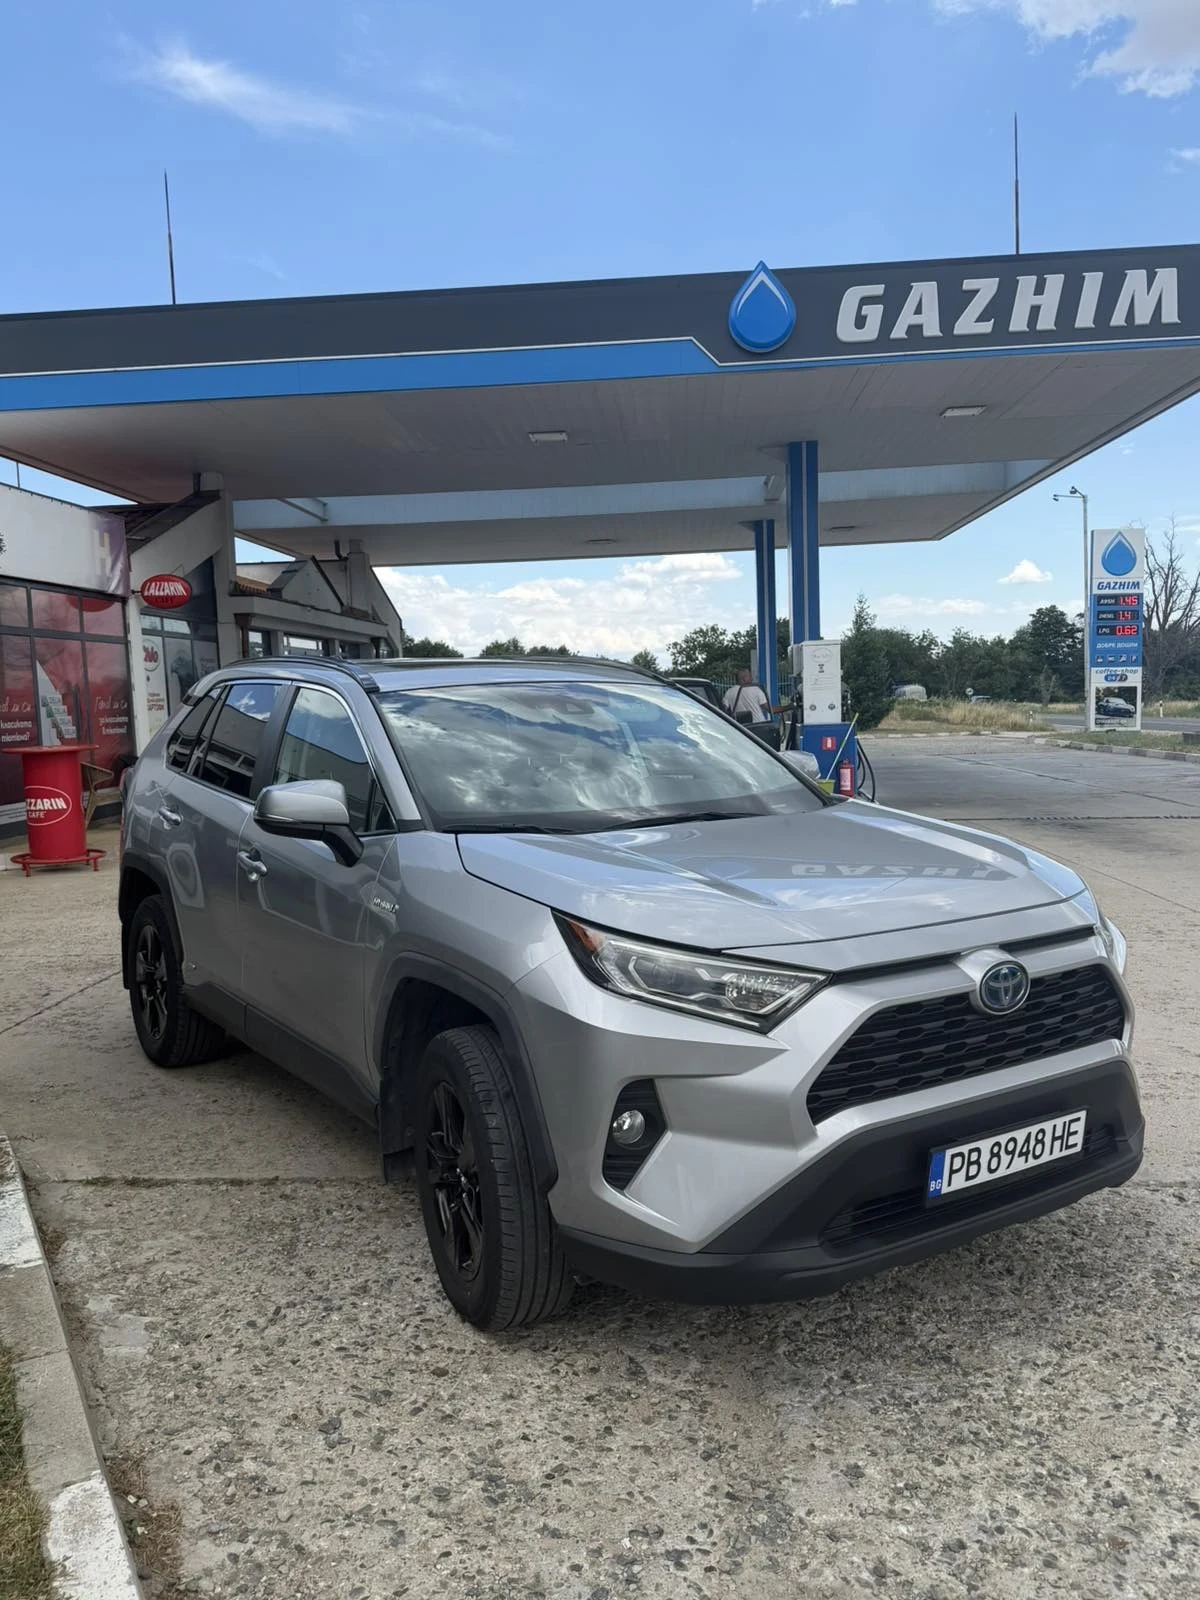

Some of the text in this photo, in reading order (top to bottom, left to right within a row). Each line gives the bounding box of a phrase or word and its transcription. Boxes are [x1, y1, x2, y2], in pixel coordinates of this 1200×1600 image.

[836, 267, 1181, 343] GAZHIM
[143, 581, 187, 596] LAZZARIN
[1097, 581, 1140, 590] GAZHIM
[1116, 625, 1137, 635] 0.62
[26, 797, 67, 811] ZZARIN
[28, 810, 45, 819] CAFE
[947, 1116, 1081, 1188] PB 8948 HE
[929, 1179, 942, 1192] BG
